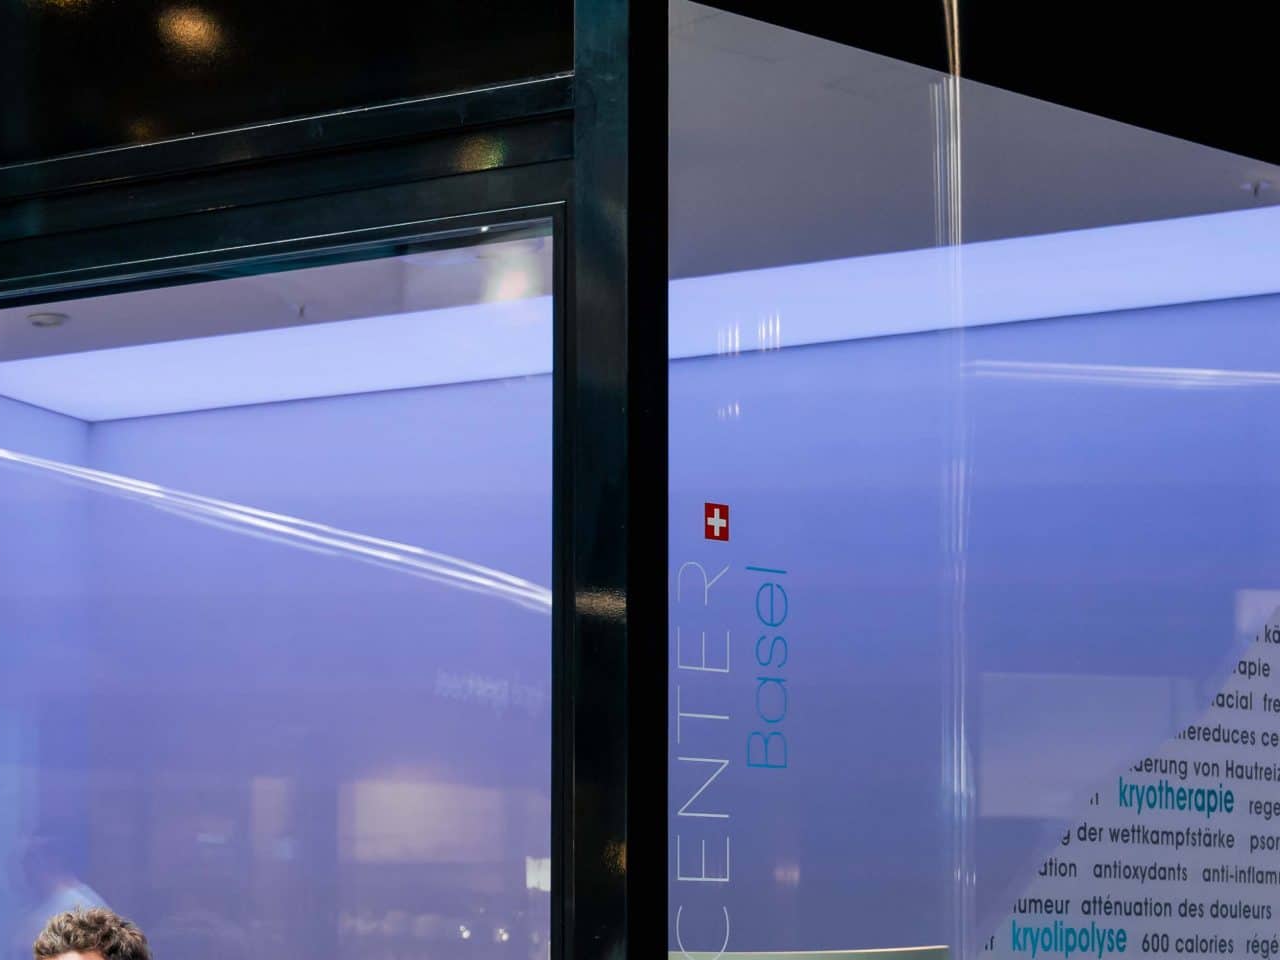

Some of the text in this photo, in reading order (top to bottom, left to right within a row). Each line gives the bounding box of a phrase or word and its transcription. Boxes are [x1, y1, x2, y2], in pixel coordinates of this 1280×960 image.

[745, 566, 788, 768] Basel
[1119, 777, 1233, 815] kryotherapie
[1109, 824, 1234, 850] wettkampfstärke
[1093, 861, 1187, 883] antioxydants
[1081, 895, 1271, 919] atténuation douleurs
[1011, 920, 1127, 958] kryolipolyse
